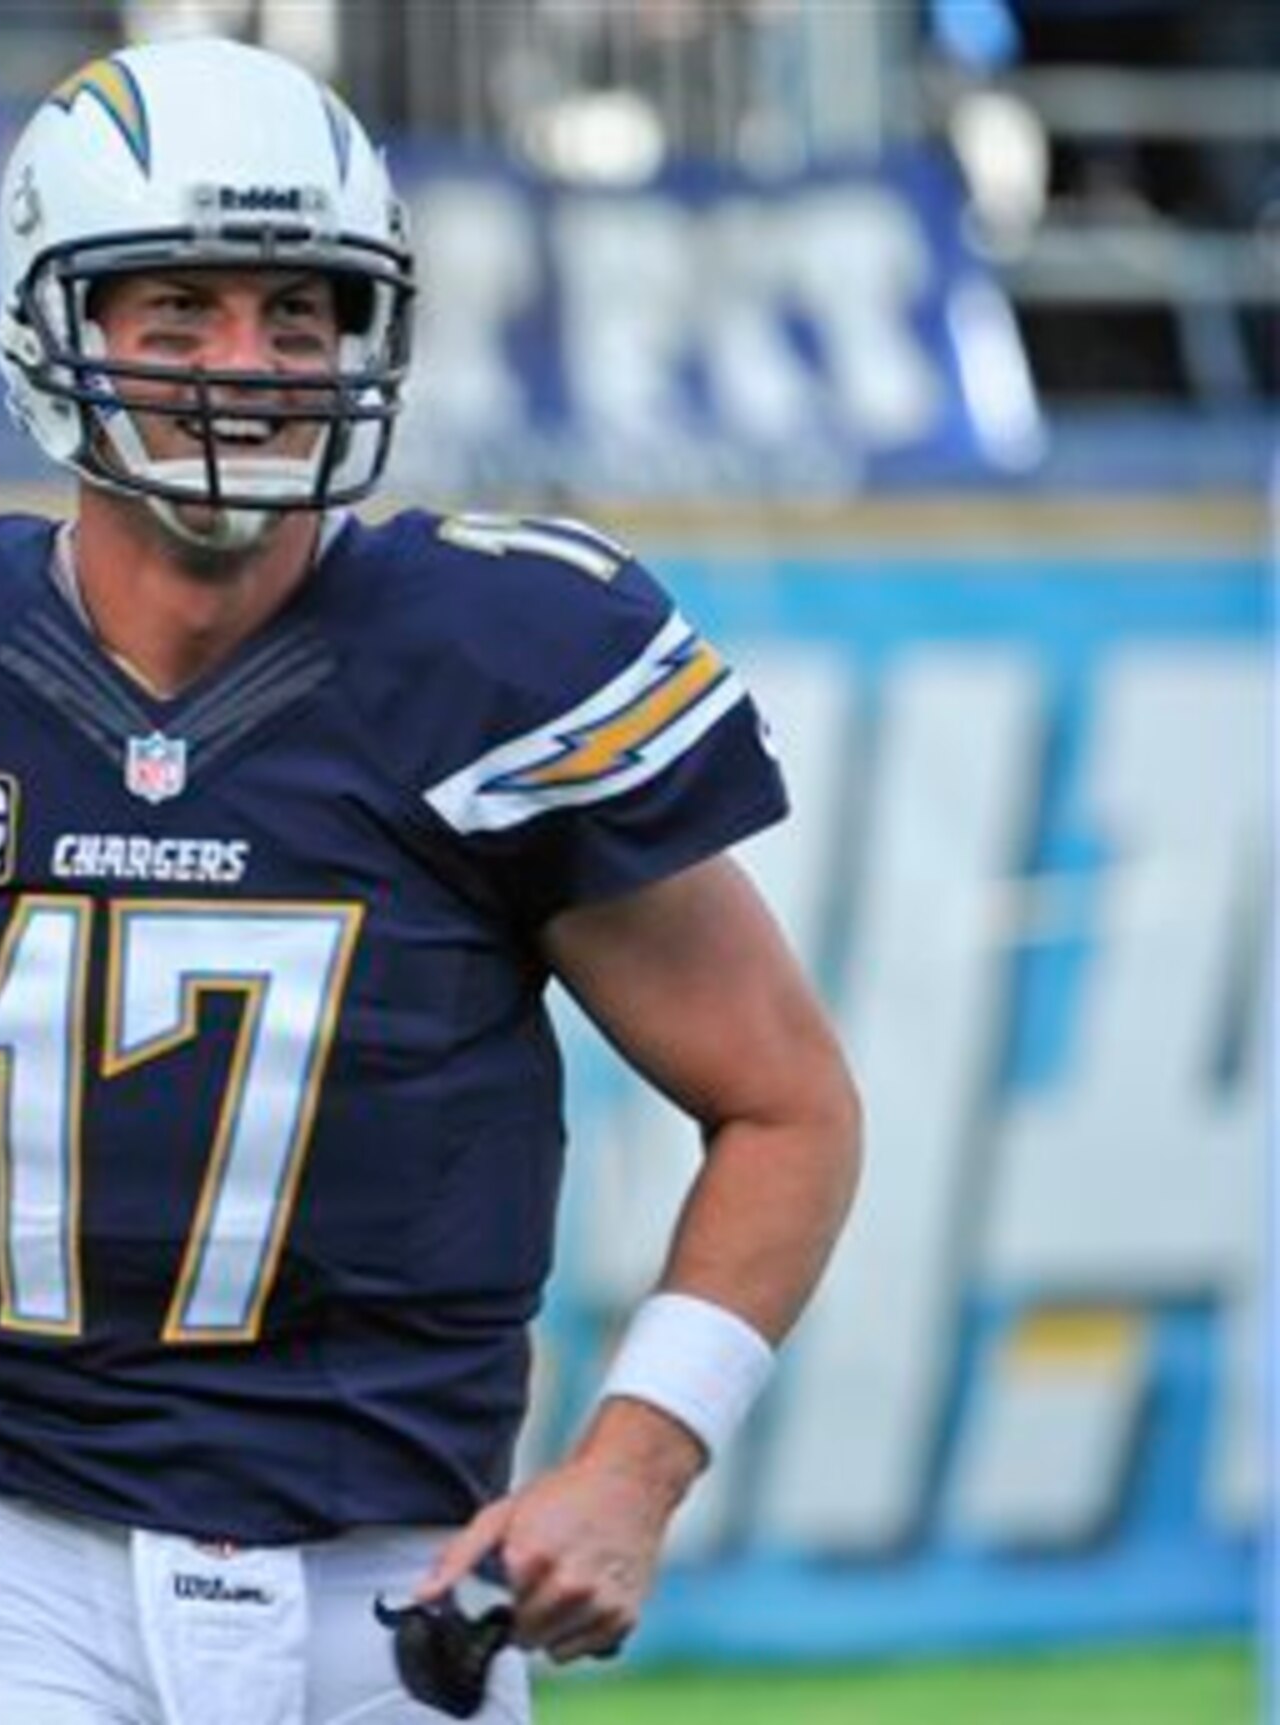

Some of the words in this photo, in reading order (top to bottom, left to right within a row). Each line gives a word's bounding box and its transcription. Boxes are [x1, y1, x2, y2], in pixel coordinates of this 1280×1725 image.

[220, 184, 300, 211] Riddell
[51, 834, 251, 882] CHARGERS
[172, 1572, 275, 1607] Wilson
